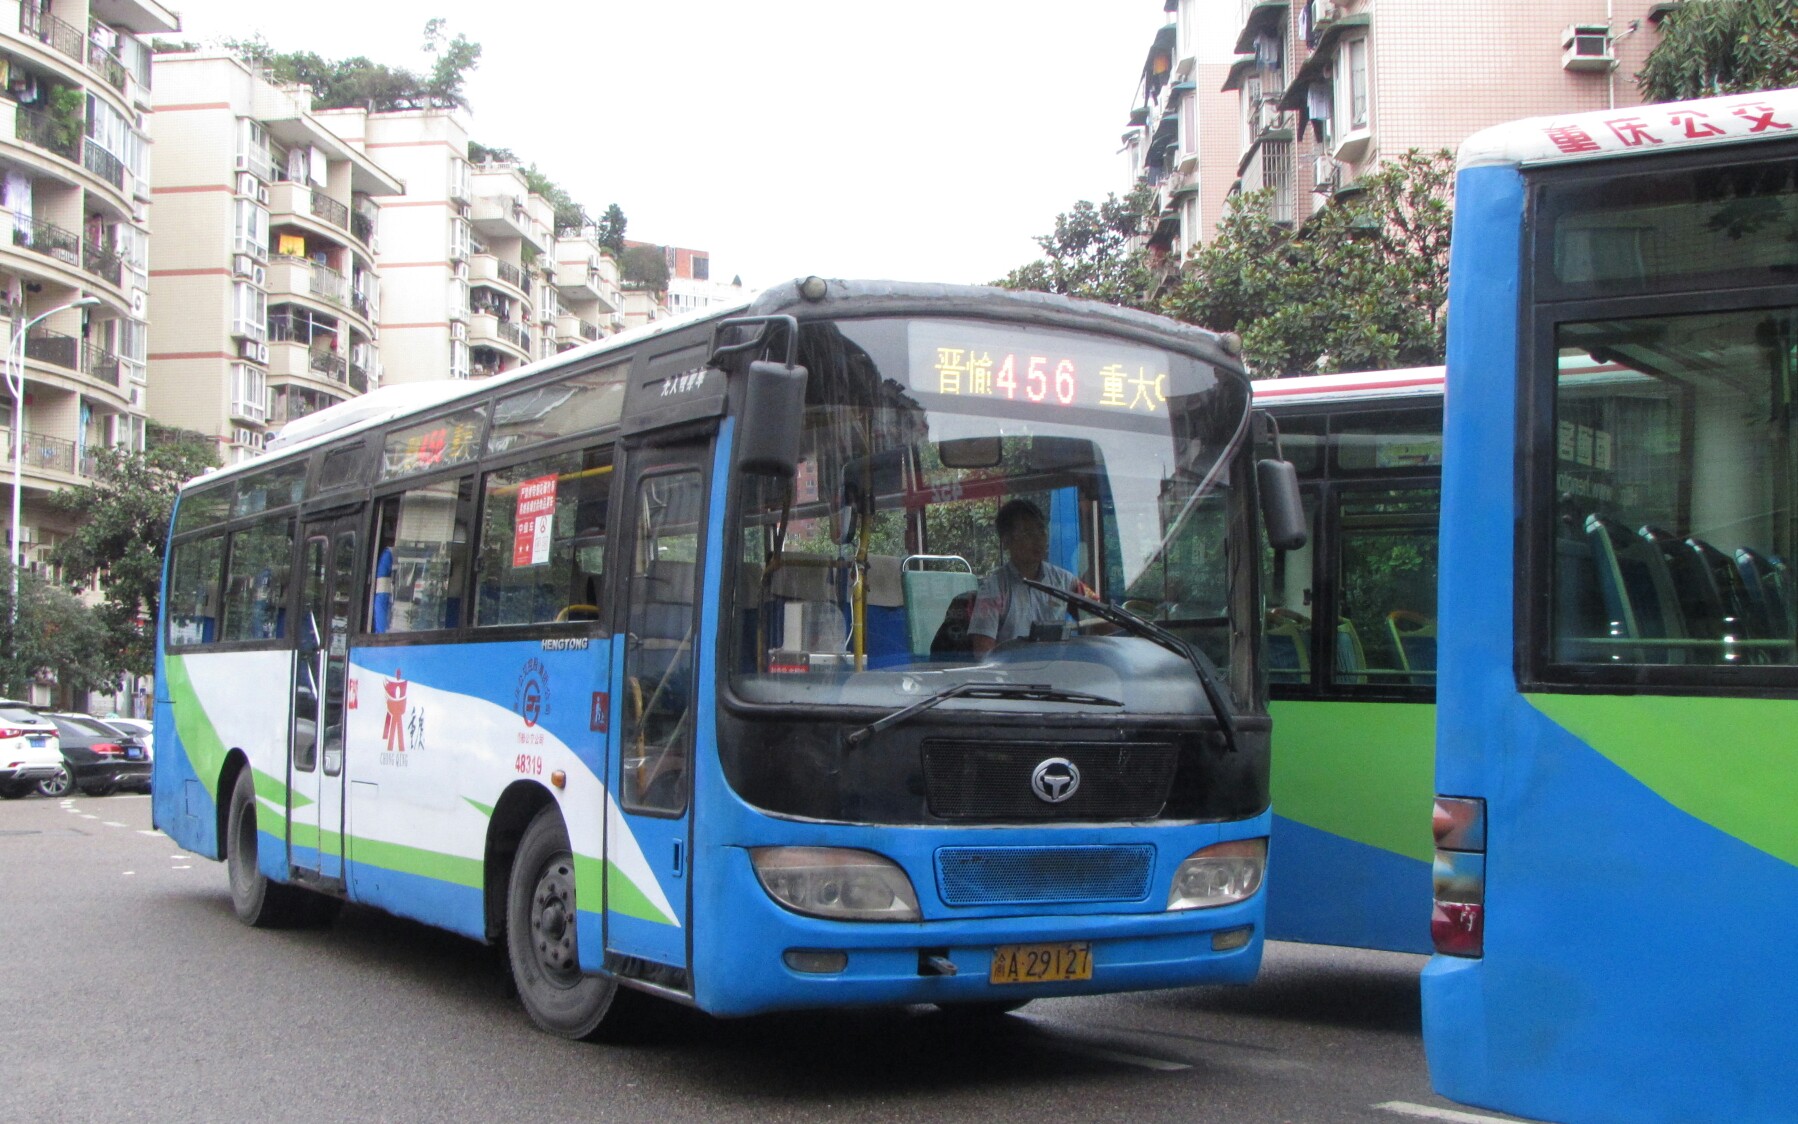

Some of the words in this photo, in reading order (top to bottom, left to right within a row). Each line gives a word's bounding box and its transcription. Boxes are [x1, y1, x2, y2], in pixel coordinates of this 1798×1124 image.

[1541, 101, 1793, 154] 重庆公交
[996, 353, 1075, 404] 456
[541, 637, 588, 650] HENGTONG
[515, 753, 542, 775] 48319
